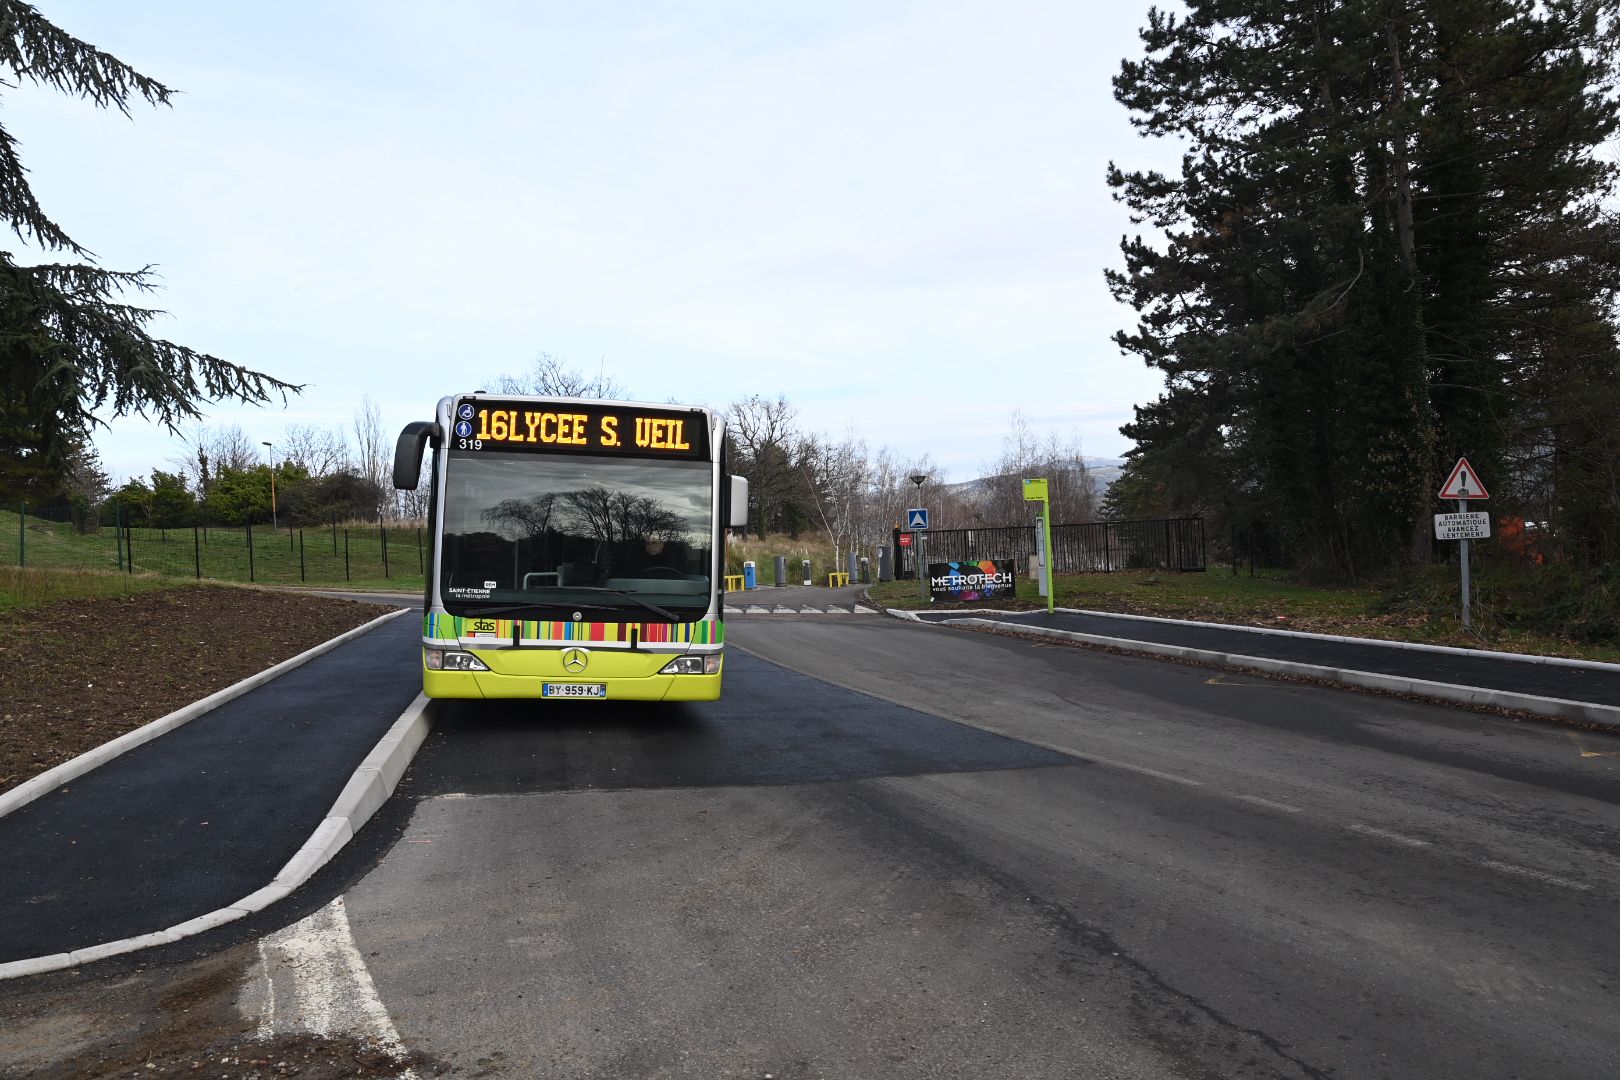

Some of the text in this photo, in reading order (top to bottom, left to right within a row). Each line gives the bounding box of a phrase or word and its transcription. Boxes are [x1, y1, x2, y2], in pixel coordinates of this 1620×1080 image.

[600, 416, 621, 447] S.
[635, 417, 690, 450] WEIL
[459, 438, 483, 451] 319
[931, 572, 1012, 587] METROTECH
[474, 620, 494, 630] stas
